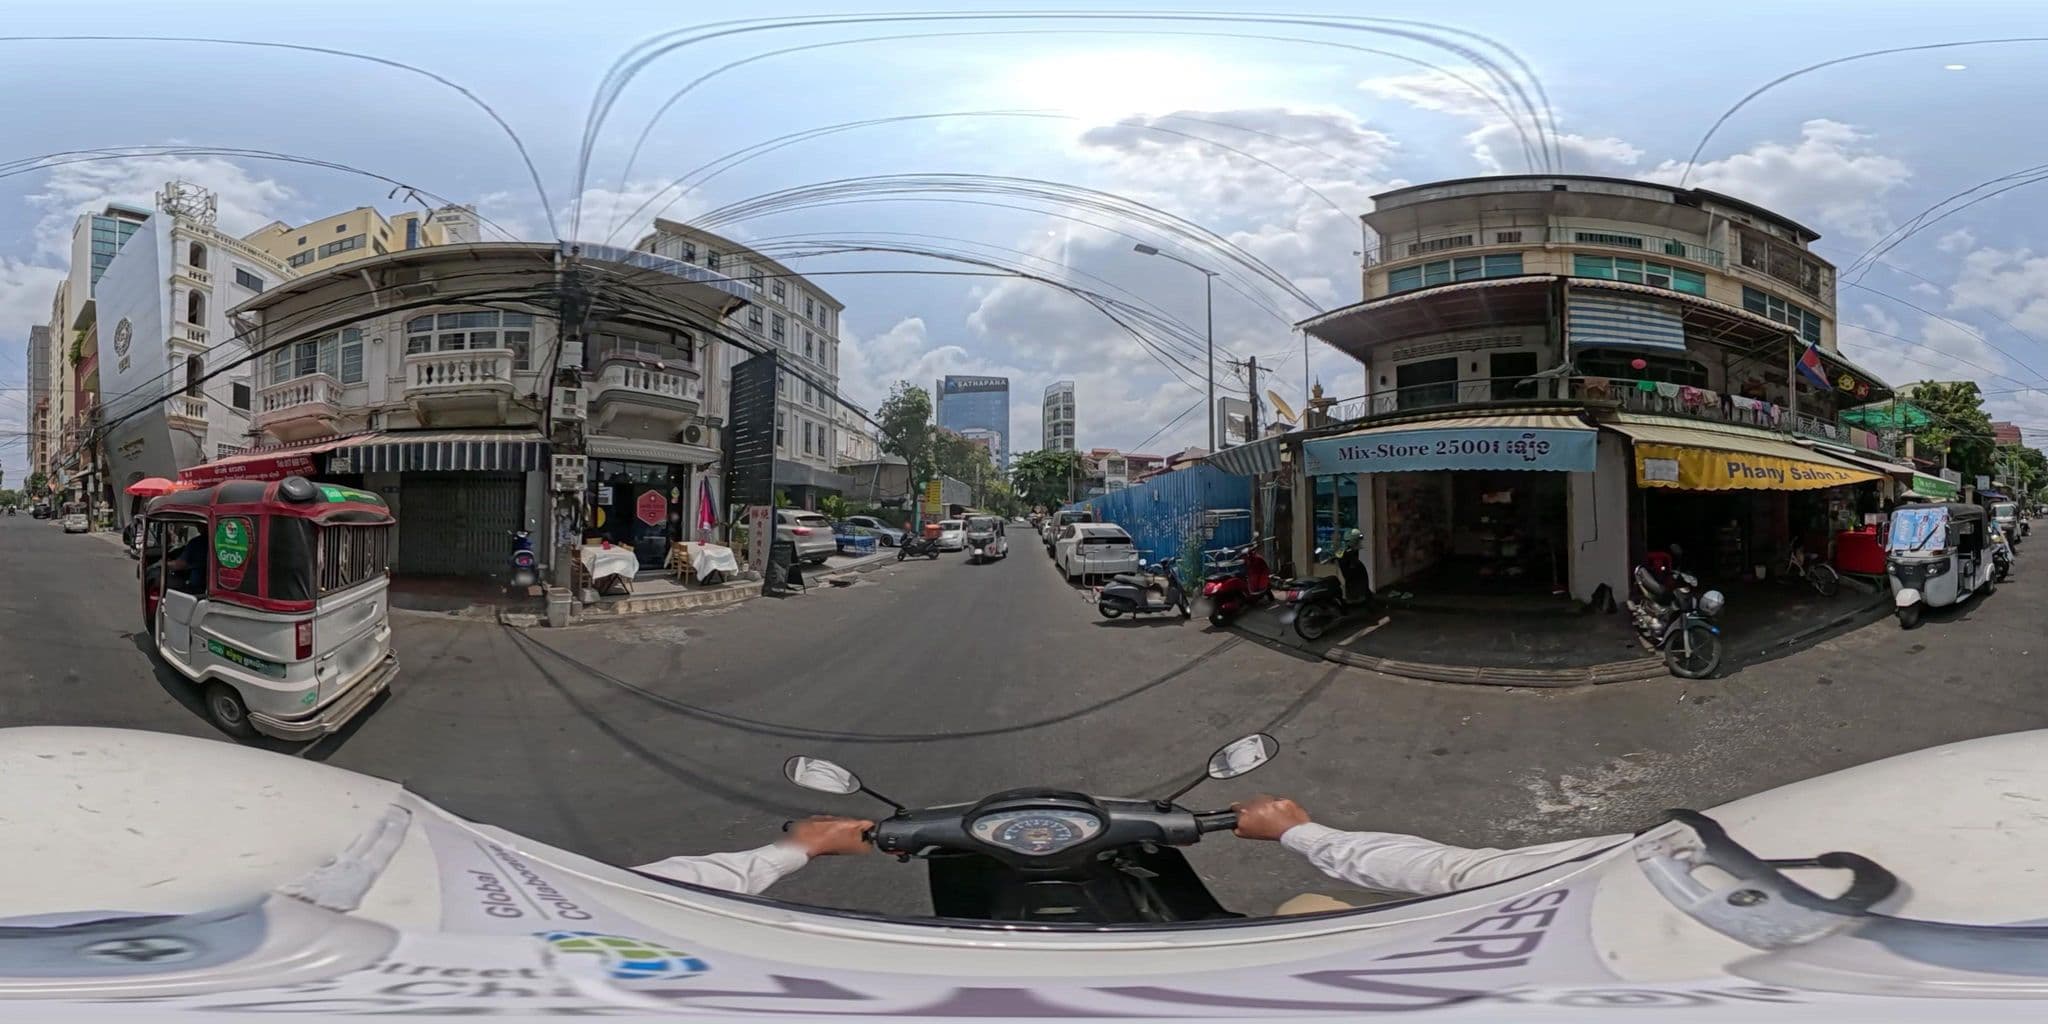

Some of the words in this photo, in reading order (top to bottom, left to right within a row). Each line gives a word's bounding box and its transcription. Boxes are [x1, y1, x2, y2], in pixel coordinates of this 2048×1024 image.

[957, 380, 1007, 388] SATHAPANA
[1338, 442, 1430, 462] Mix-Store
[1727, 461, 1785, 483] Phany
[1789, 466, 1835, 481] Salon
[219, 549, 243, 564] Grab
[467, 869, 525, 920] Global
